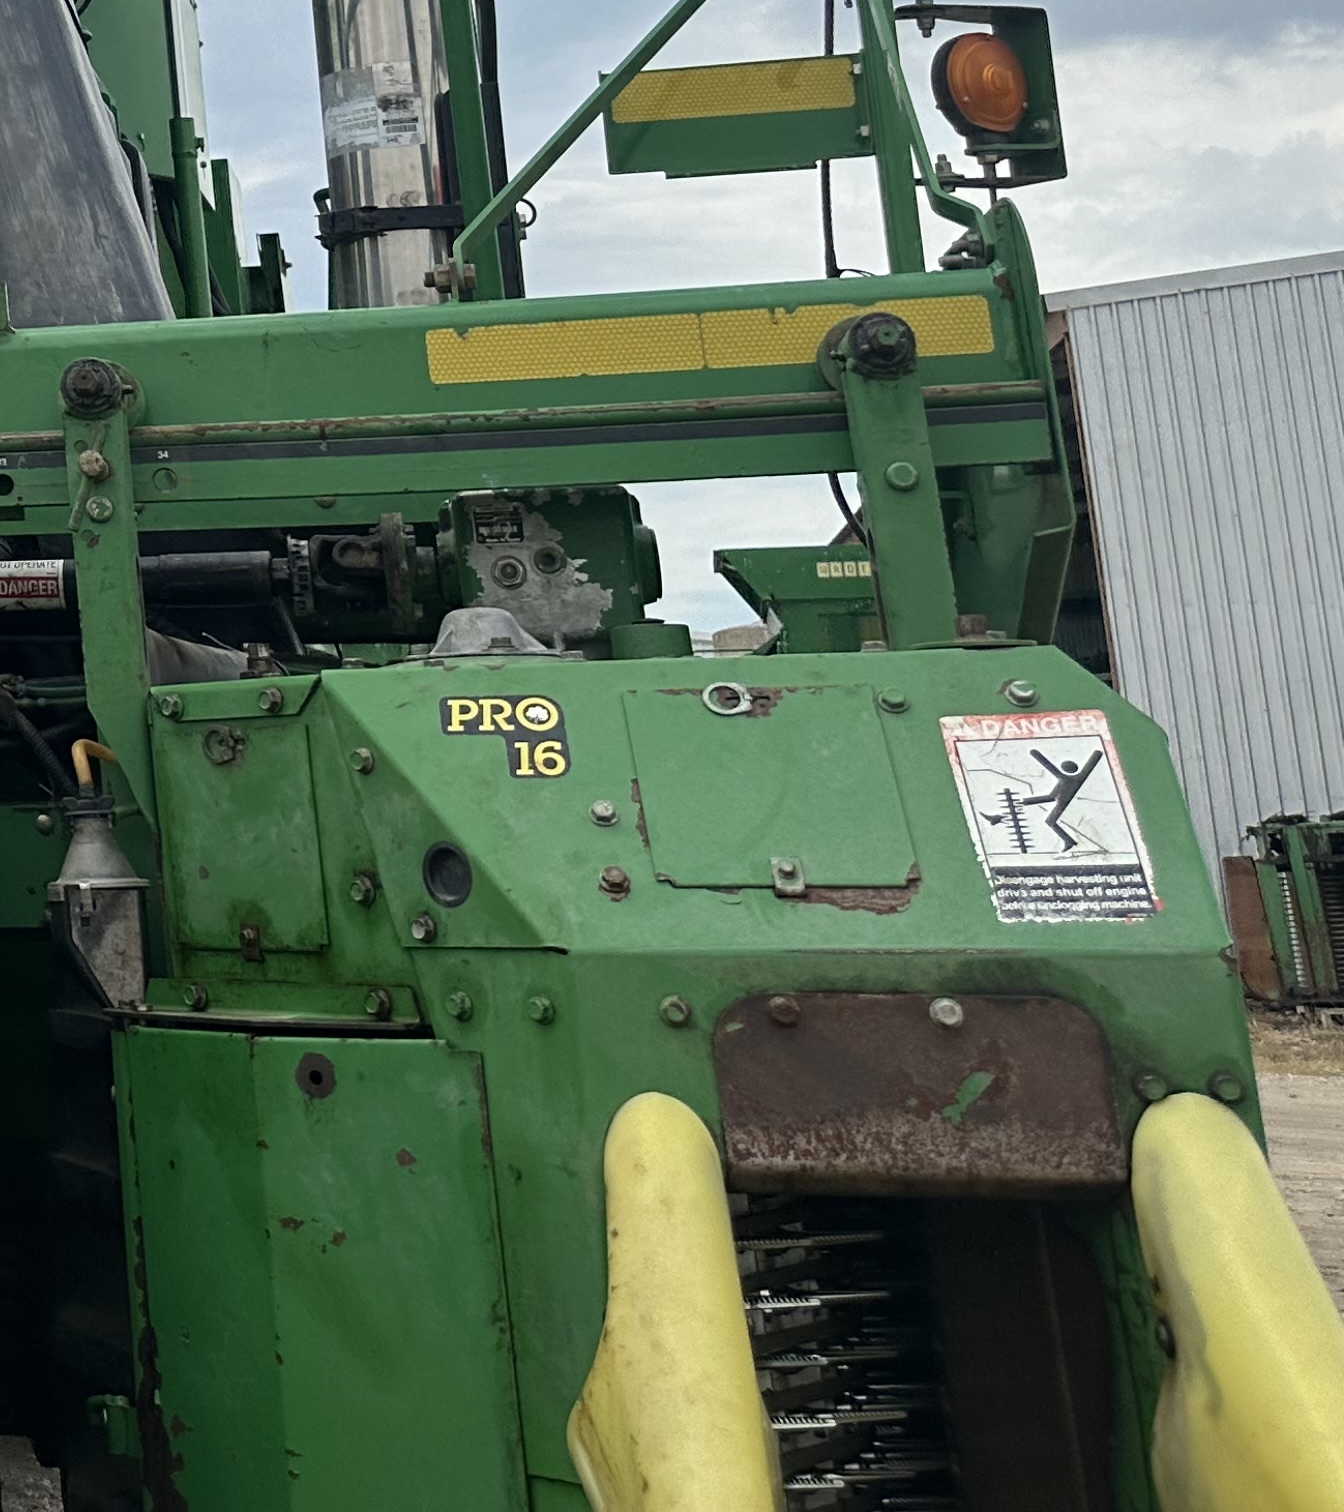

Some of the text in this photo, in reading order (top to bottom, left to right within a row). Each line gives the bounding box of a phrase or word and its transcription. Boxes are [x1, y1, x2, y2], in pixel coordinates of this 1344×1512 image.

[157, 450, 169, 460] 34
[446, 697, 560, 732] PRO
[981, 715, 1098, 739] DANGER
[514, 740, 566, 776] 16
[1055, 874, 1118, 886] harvesting
[1119, 873, 1142, 883] unit
[1029, 888, 1053, 897] and
[1055, 887, 1084, 897] shut
[1086, 886, 1104, 897] off
[1105, 886, 1147, 898] engine
